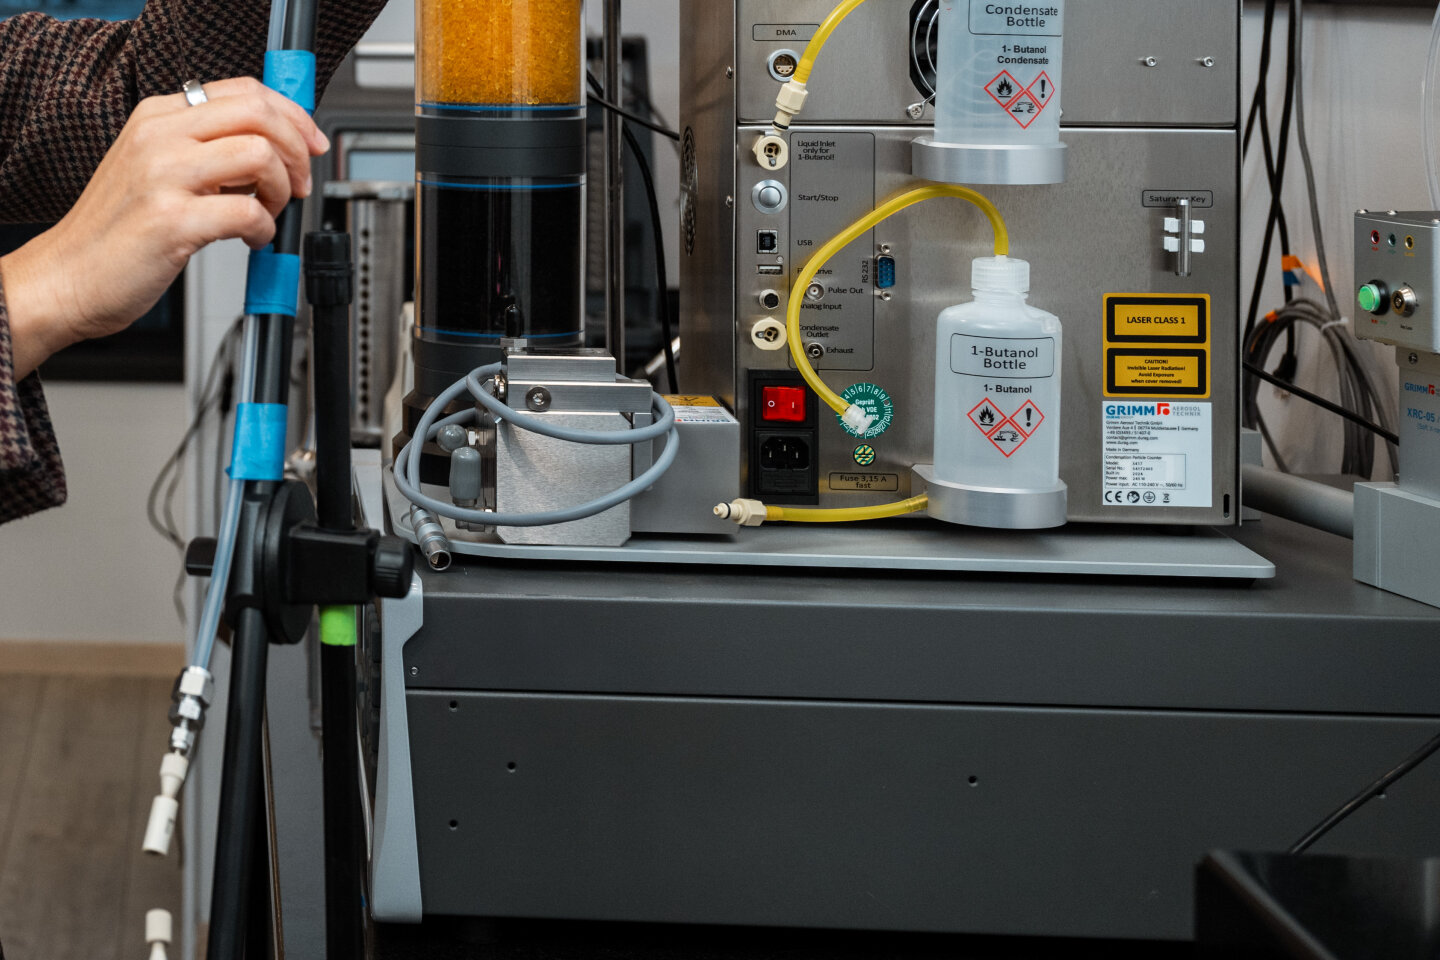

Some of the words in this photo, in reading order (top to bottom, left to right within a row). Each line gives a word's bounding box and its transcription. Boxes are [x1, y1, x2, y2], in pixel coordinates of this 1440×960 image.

[985, 4, 1058, 16] Condensate
[1007, 17, 1046, 27] Bottle
[1014, 45, 1046, 54] Butanol
[997, 56, 1049, 64] Condensate
[862, 275, 868, 283] RS
[971, 345, 1038, 358] 1-Butanol
[984, 358, 1026, 369] Bottle
[996, 384, 1032, 394] Butanol
[1404, 382, 1428, 394] GRIMM
[1106, 405, 1155, 416] GRIMM
[1407, 408, 1435, 422] XRC-05
